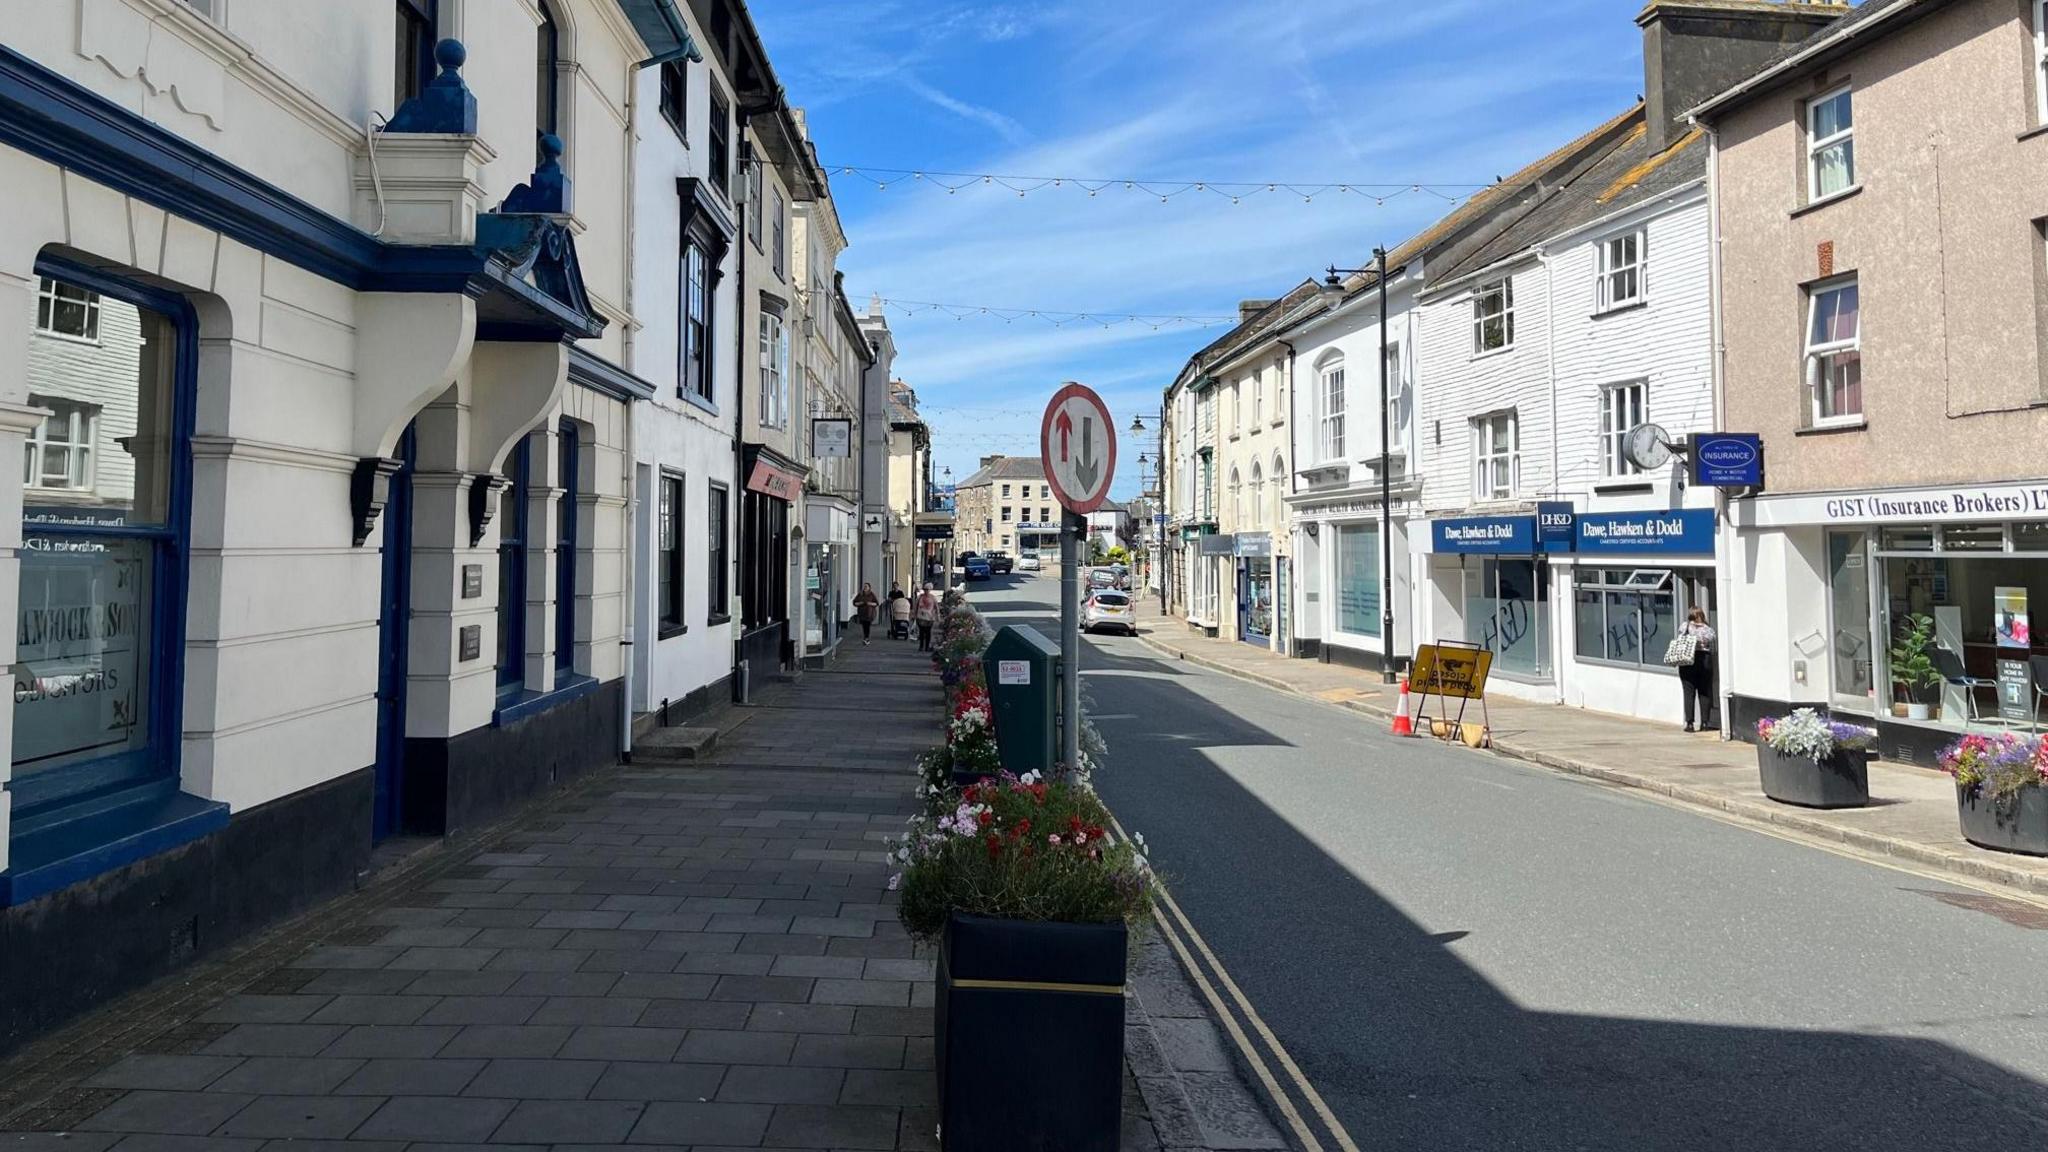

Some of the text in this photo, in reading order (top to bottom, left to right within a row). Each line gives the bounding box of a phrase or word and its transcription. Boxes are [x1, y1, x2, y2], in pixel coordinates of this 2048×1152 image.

[1705, 452, 1750, 460] INSURANCE
[1350, 499, 1384, 512] MANAGEMEN
[1390, 497, 1403, 508] LTD
[1826, 498, 1865, 518] GIST
[1868, 495, 1948, 517] (Insurance
[1541, 513, 1572, 525] DH&D
[1583, 518, 1683, 538] Dawe, Hawken & Dodd
[1445, 523, 1513, 540] Dawe, Hawken & Dodd
[18, 605, 91, 646] ANCOCK
[13, 669, 119, 704] OLICITORS
